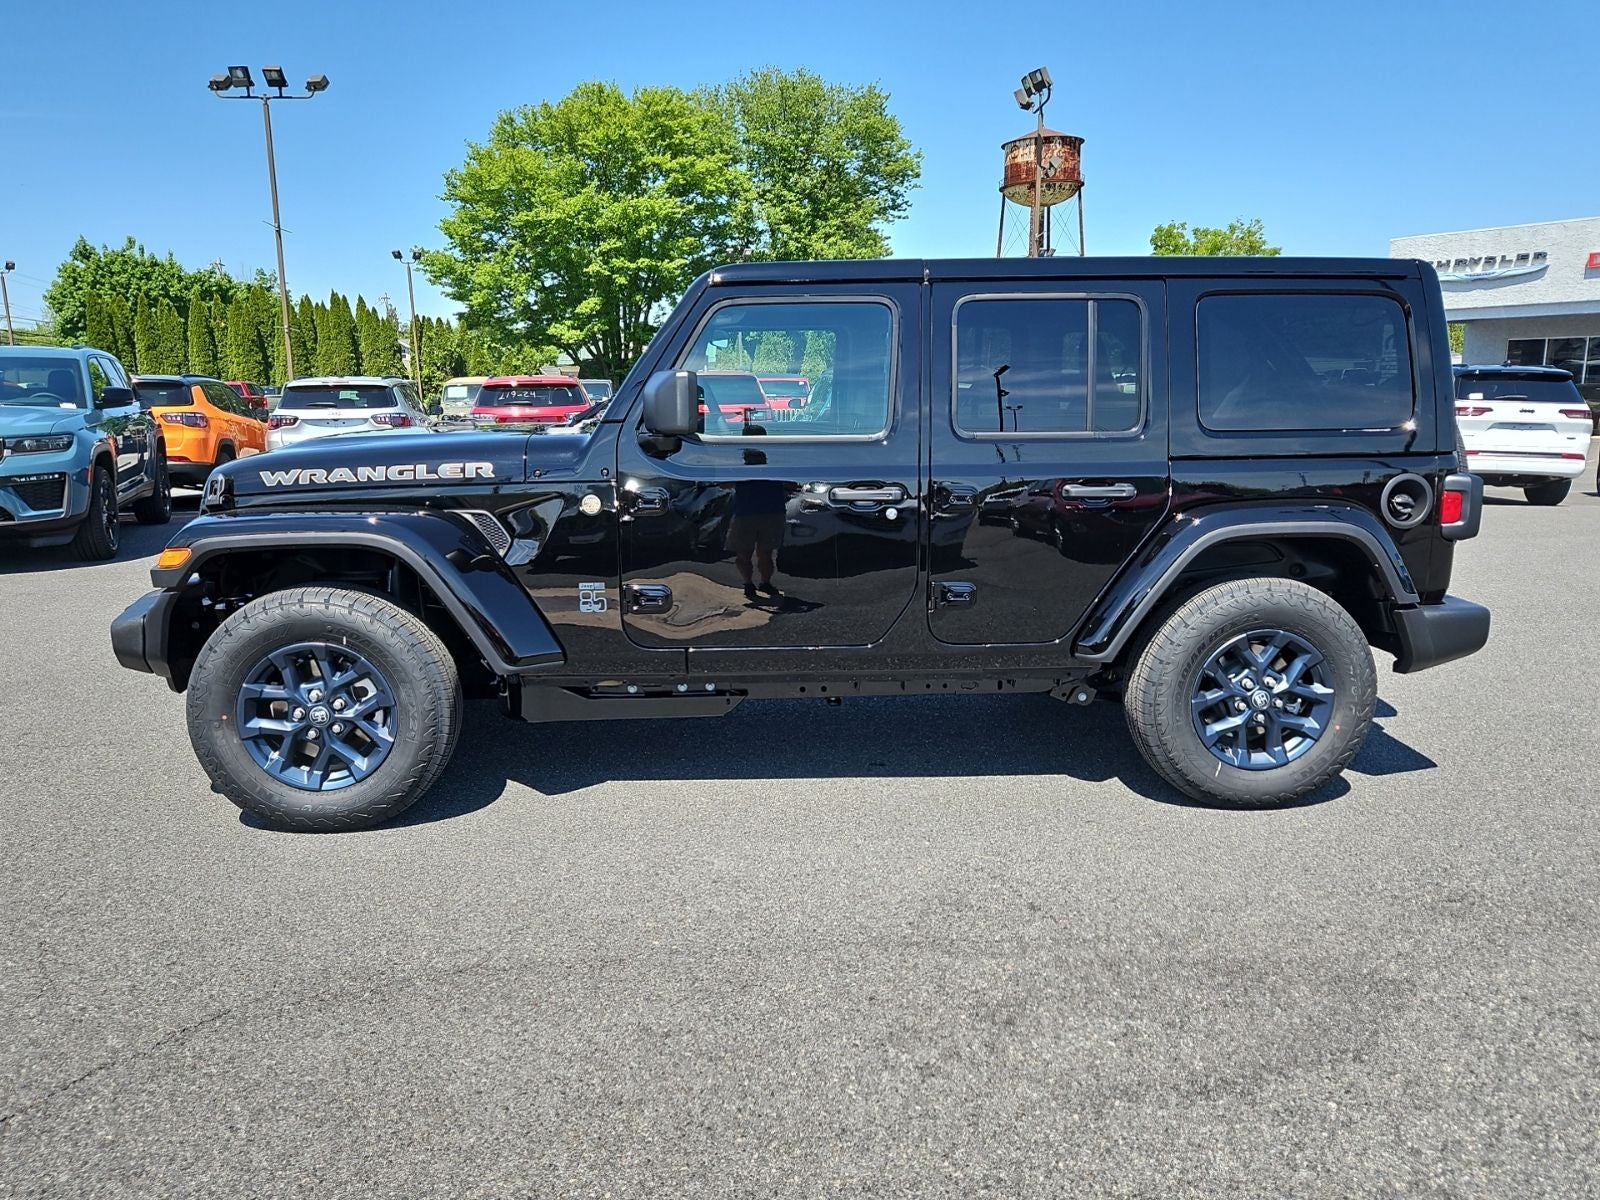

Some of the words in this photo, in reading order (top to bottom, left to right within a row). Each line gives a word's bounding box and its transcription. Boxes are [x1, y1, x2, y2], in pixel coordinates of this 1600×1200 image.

[1426, 252, 1548, 268] HRYSLER
[259, 462, 495, 487] WRANGLER
[580, 590, 607, 612] 85
